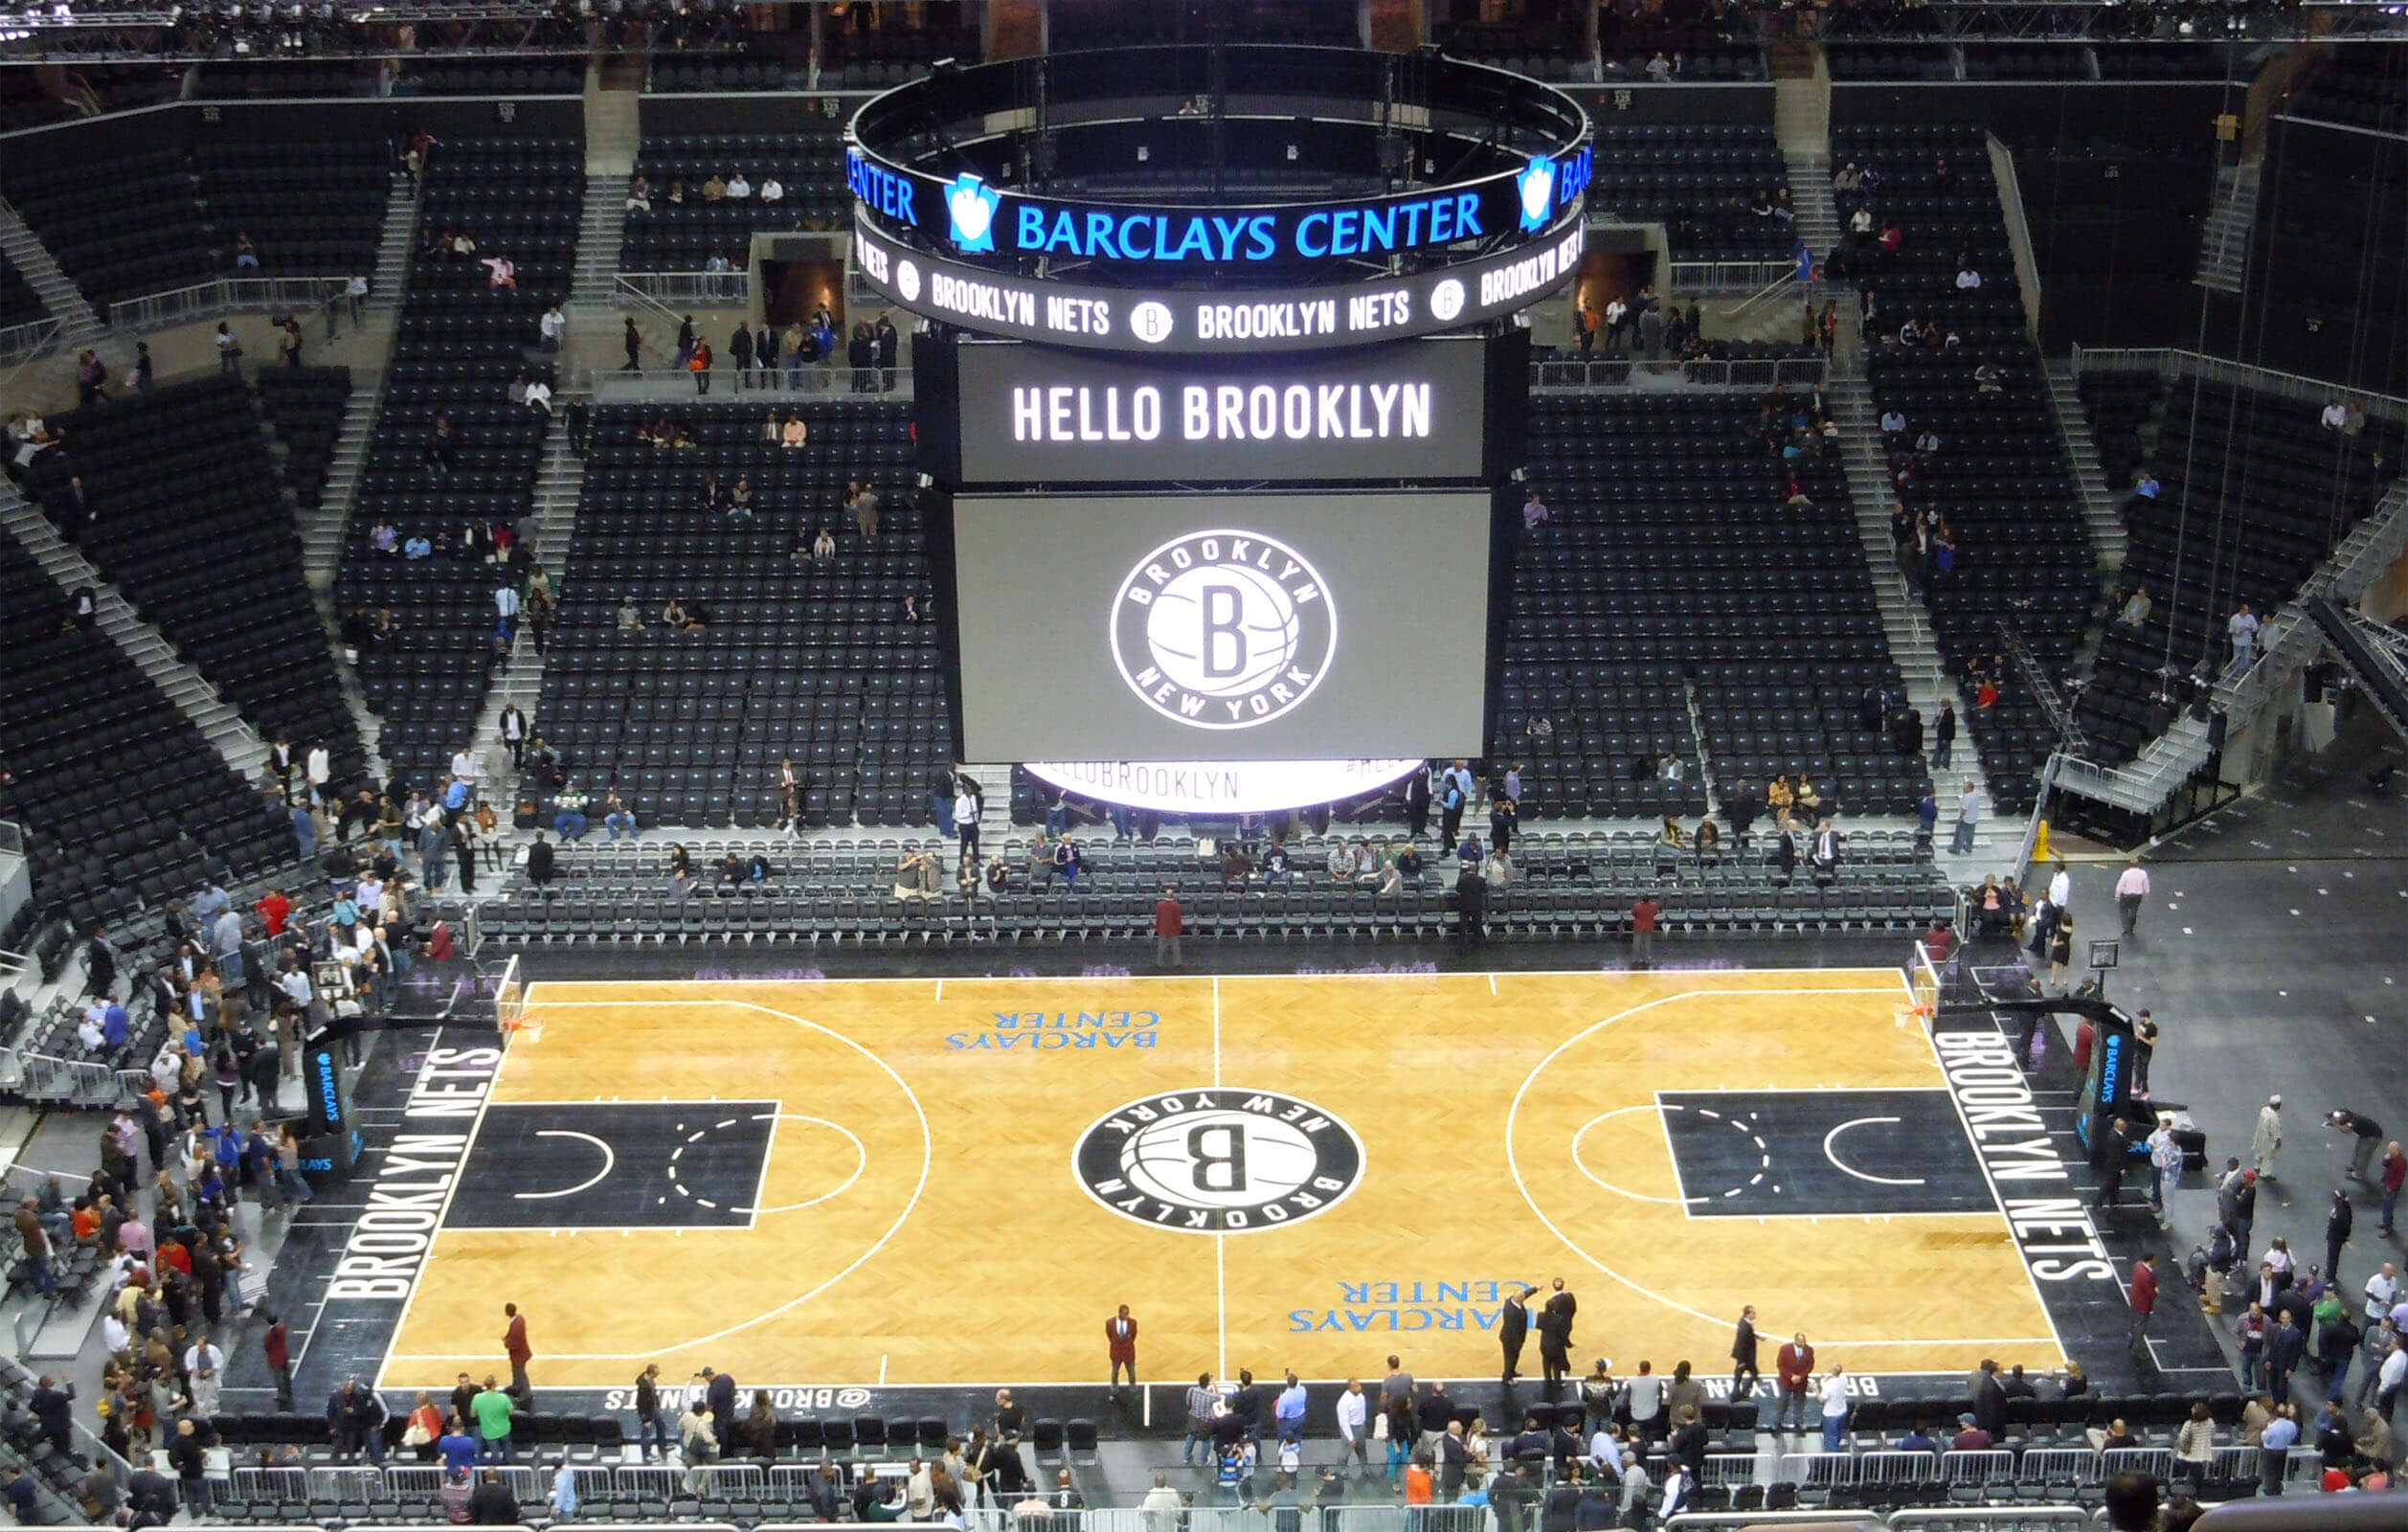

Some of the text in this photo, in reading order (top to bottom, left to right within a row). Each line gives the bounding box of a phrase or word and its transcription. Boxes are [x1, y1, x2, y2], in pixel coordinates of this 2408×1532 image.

[1017, 192, 1483, 261] BARCLAYS CENTER
[932, 273, 1034, 327] BROOKLYN
[1047, 295, 1110, 335] NETS
[1481, 248, 1557, 306] BROOKLYN
[1198, 288, 1410, 339] BROOKLYN NETS
[1013, 383, 1430, 440] HELLO BROOKLYN
[1127, 538, 1319, 606] BROOKLYN
[1202, 585, 1247, 679] B
[1136, 665, 1314, 721] NEW YORK
[944, 1032, 1158, 1050] BARCLAYS
[992, 1010, 1161, 1029] CENTER
[320, 1066, 339, 1121] BARCLAYS
[2102, 1048, 2119, 1102] BARCLAYS
[1102, 1091, 1332, 1137] NEW YORK
[327, 1048, 503, 1299] BROOKLYN NETS
[1186, 1123, 1247, 1193] B
[1935, 1030, 2115, 1283] BROOKLYN NETS
[1092, 1176, 1347, 1230] BROOKLYN
